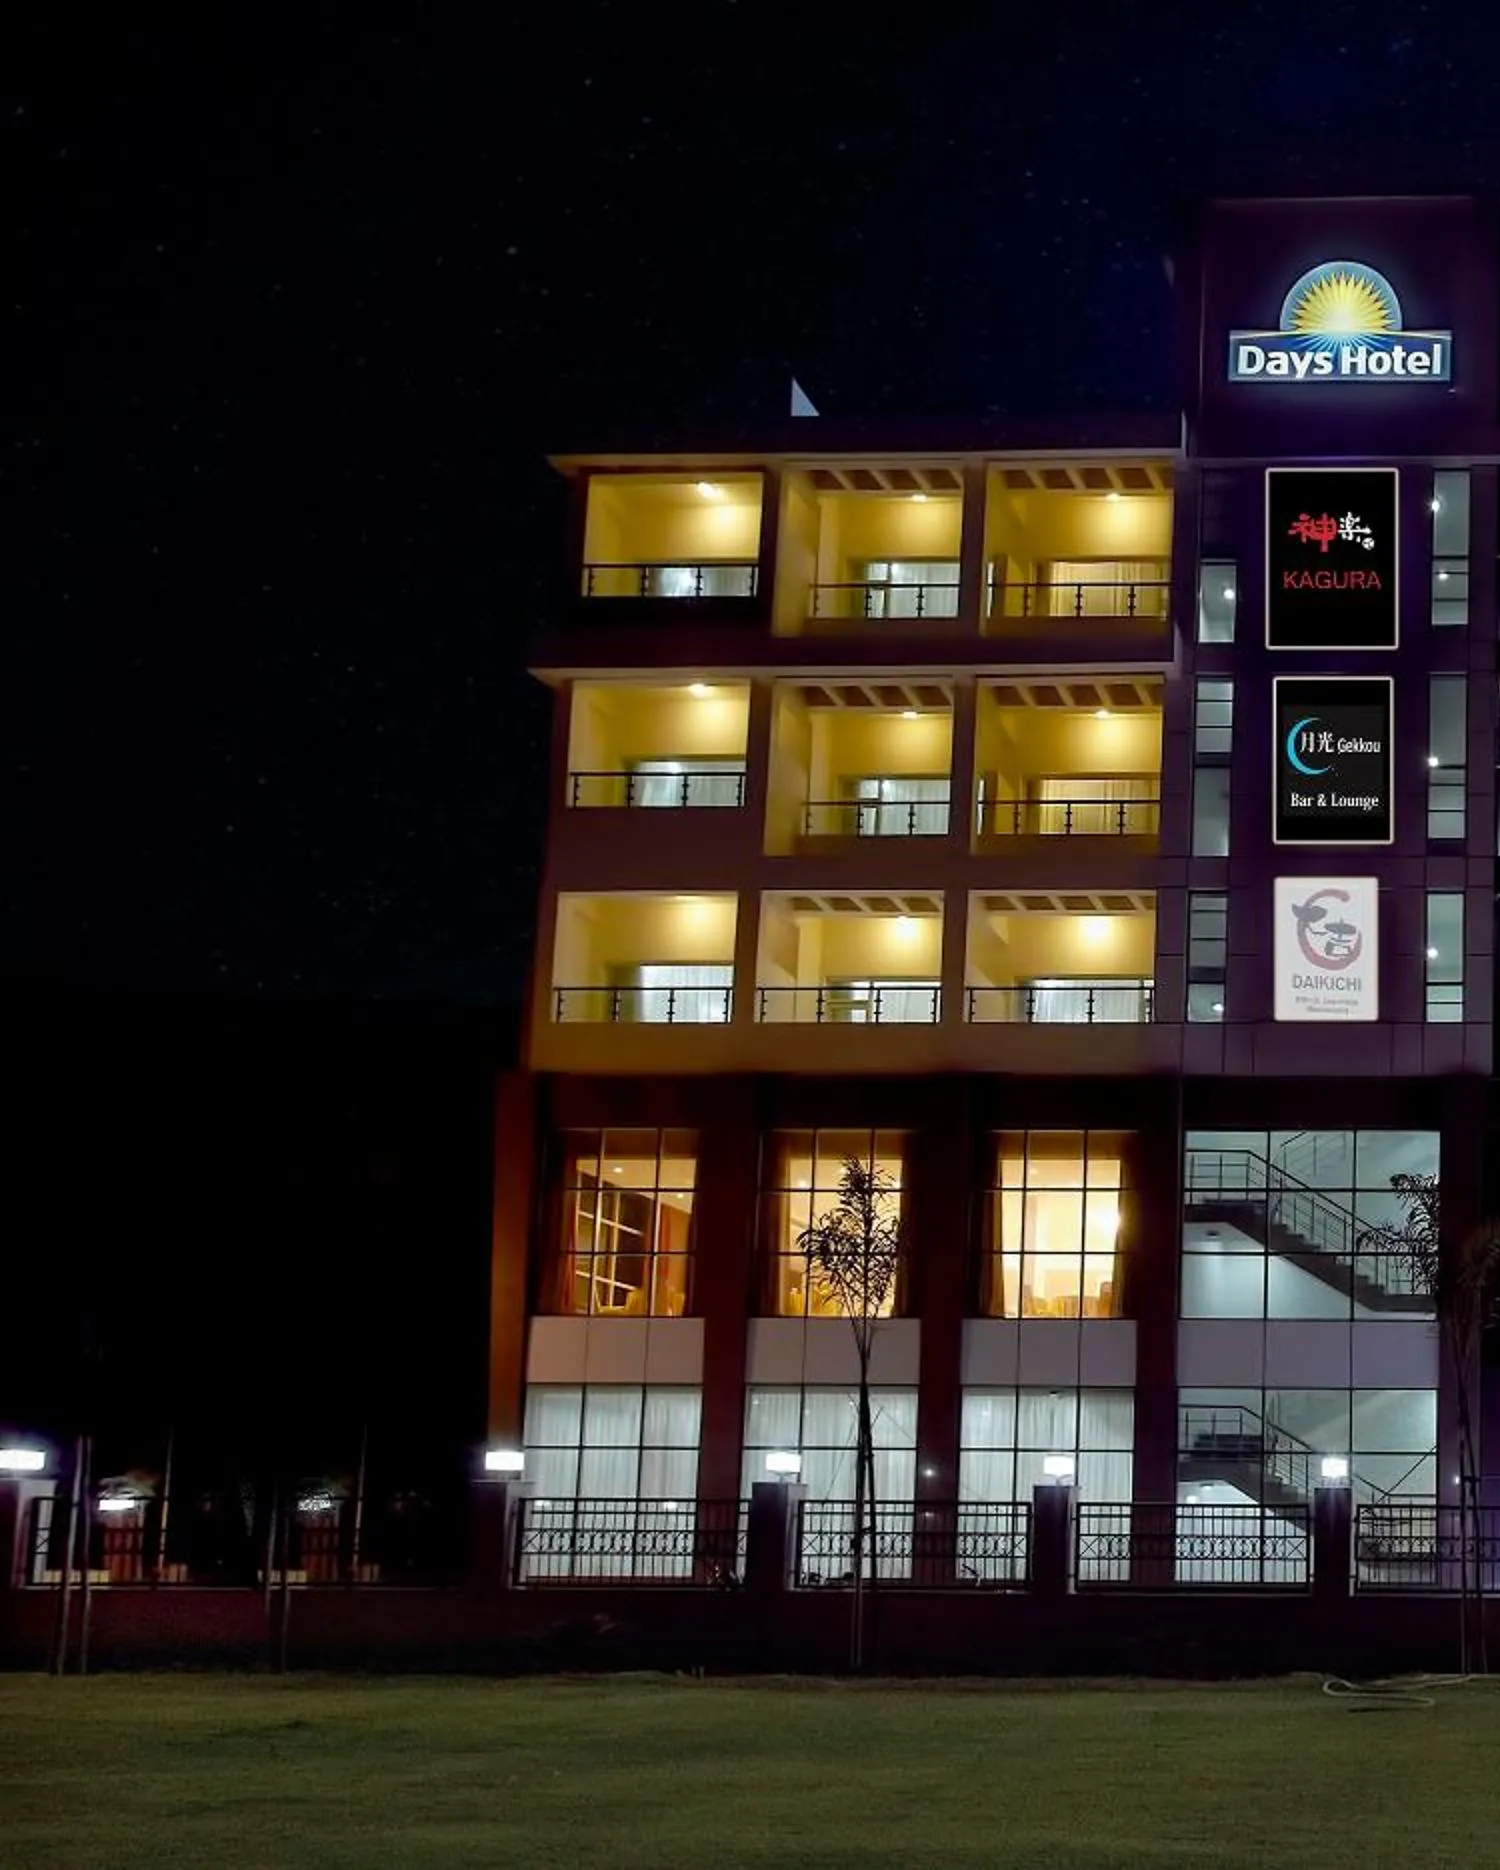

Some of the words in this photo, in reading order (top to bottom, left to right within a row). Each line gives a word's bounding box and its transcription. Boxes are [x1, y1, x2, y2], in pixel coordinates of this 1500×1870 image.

[1237, 345, 1333, 379] Days
[1340, 344, 1442, 375] Hotel
[1283, 570, 1382, 590] KAGURA
[1337, 737, 1381, 753] Gekkou
[1290, 793, 1314, 807] Bar
[1317, 794, 1327, 807] &
[1331, 793, 1379, 810] Lounge
[1292, 974, 1362, 991] DAIKICHI
